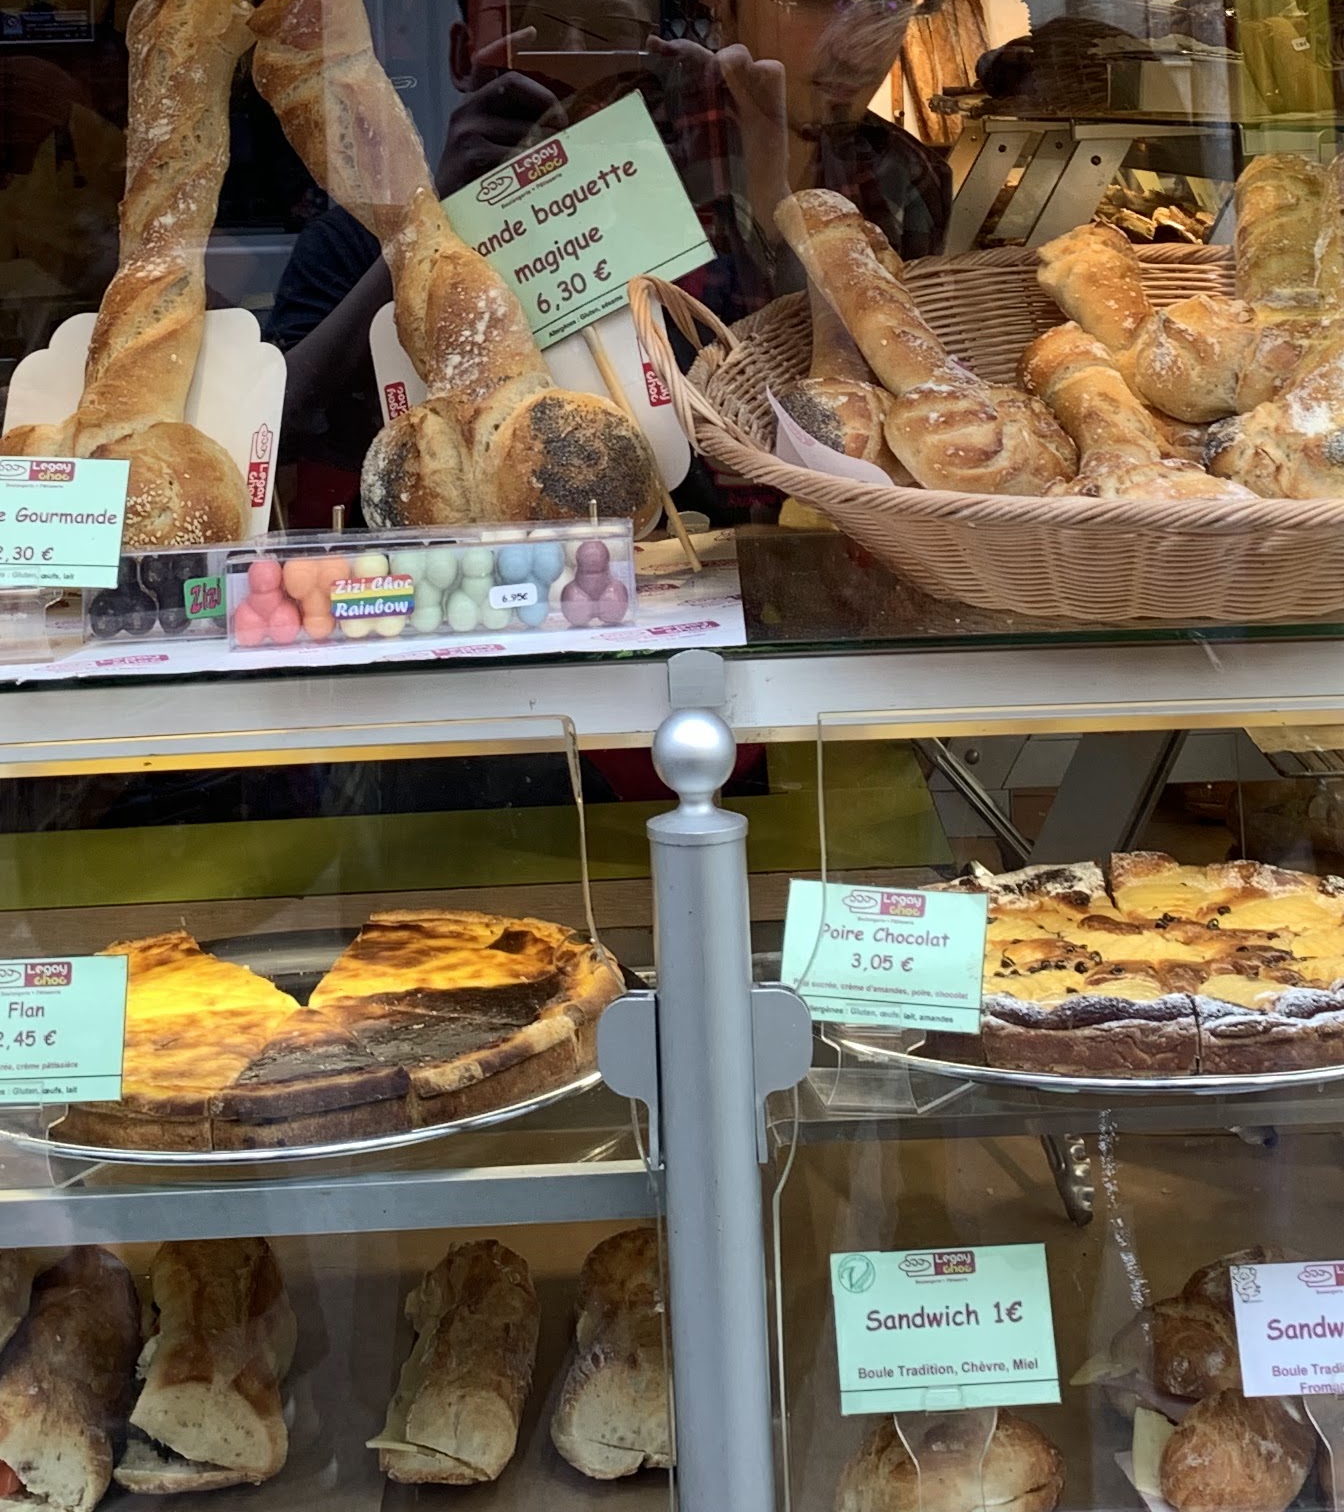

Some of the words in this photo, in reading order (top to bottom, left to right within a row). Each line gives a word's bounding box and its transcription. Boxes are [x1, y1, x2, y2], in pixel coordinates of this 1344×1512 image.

[514, 141, 559, 174] Legay
[528, 157, 563, 181] choc
[471, 218, 527, 258] ande
[531, 159, 638, 225] baguette
[513, 225, 604, 284] magique
[536, 273, 587, 313] 6,30
[593, 259, 612, 282] €
[32, 461, 72, 474] Legay
[38, 470, 70, 481] choc
[15, 506, 118, 525] Gourmande
[41, 546, 54, 561] €
[335, 580, 367, 595] Zizi
[370, 574, 413, 591] Choc
[335, 598, 409, 618] Rainbow
[883, 894, 923, 908] Legay
[889, 905, 921, 916] choc
[822, 923, 864, 942] Poire
[873, 927, 951, 948] Chocolat
[27, 964, 68, 976] Legay
[851, 954, 893, 973] 3,05
[900, 957, 914, 972] €
[34, 975, 67, 986] choc
[8, 1002, 45, 1019] Flan
[43, 1030, 57, 1046] €
[935, 1252, 972, 1265] Legay
[942, 1262, 973, 1274] choc
[866, 1302, 980, 1331] Sandwich
[994, 1301, 1023, 1324] 1€
[858, 1367, 894, 1379] Boule
[898, 1363, 958, 1376] Tradition,
[961, 1359, 1009, 1373] Chèvre,
[1013, 1358, 1039, 1370] Miel
[1272, 1365, 1308, 1377] Boule
